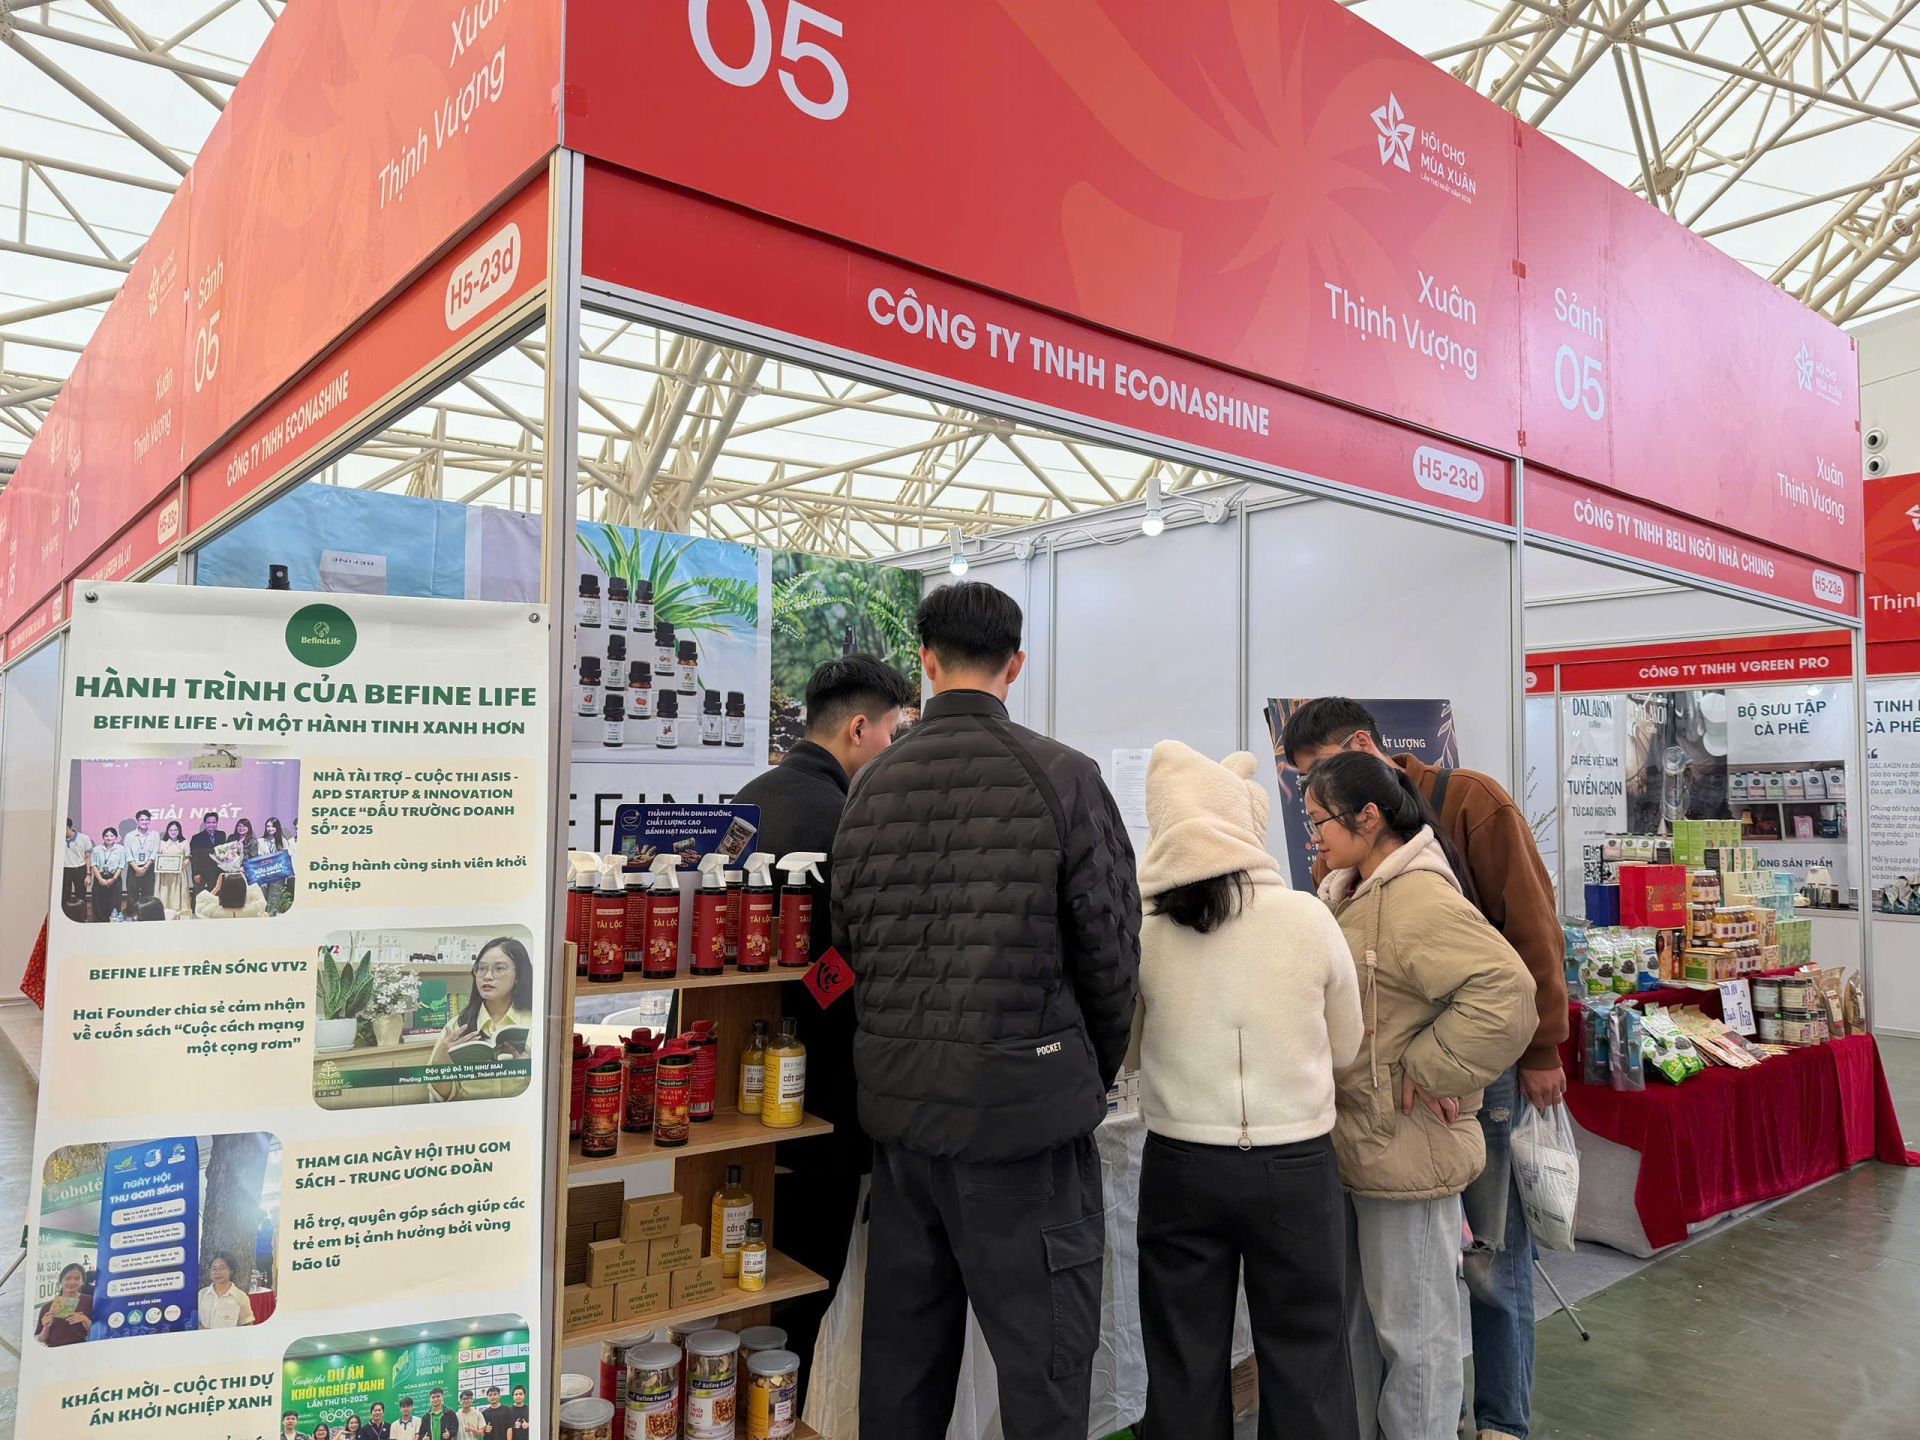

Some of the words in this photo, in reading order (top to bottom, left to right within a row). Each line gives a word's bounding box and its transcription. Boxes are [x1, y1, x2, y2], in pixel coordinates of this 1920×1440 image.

[688, 0, 849, 120] 05
[377, 136, 429, 210] Thịnh
[433, 44, 506, 133] Vượng
[1421, 129, 1440, 153] HỘI
[1442, 143, 1465, 168] CHỢ
[1421, 152, 1445, 179] MÙA
[1447, 167, 1476, 195] XUÂN
[197, 255, 224, 310] Sảnh
[451, 236, 514, 316] H5-23d
[1417, 270, 1476, 325] Xuân
[1554, 287, 1604, 342] Sảnh
[1324, 281, 1396, 342] Thịnh
[1402, 312, 1478, 381] Vượng
[194, 311, 221, 393] 05
[867, 287, 976, 350] CÔNG
[986, 324, 1019, 363] TY
[1030, 337, 1105, 389] TNHH
[1115, 364, 1269, 436] ECONASHINE
[1555, 344, 1605, 421] 05
[226, 454, 250, 488] CÔNG
[250, 444, 261, 470] TY
[261, 421, 284, 461] TNHH
[285, 369, 350, 445] ECONASHINE
[1419, 454, 1479, 492] H5-23d
[1816, 456, 1844, 489] Xuân
[1777, 471, 1808, 507] Thịnh
[1809, 487, 1845, 525] Vượng
[1573, 498, 1613, 531] CÔNG
[1617, 512, 1630, 536] TY
[1633, 519, 1663, 547] TNHH
[1666, 528, 1687, 554] BELI
[1689, 534, 1716, 563] NGÔI
[1718, 541, 1740, 569] NHÀ
[1741, 552, 1775, 580] CHUNG
[1814, 575, 1842, 599] H5-23e
[301, 636, 341, 646] BefineLife
[1639, 665, 1679, 679] CÔNG
[1682, 665, 1699, 677] TY
[1701, 662, 1737, 675] TNHH
[1740, 658, 1795, 672] VGREEN
[1799, 656, 1829, 669] PRO
[75, 666, 176, 699] HÀNH
[185, 670, 286, 702] TRÌNH
[293, 673, 357, 704] CỦA
[365, 684, 472, 706] BEFINE
[479, 687, 536, 707] LIFE
[1737, 704, 1757, 720] BỘ
[1761, 703, 1791, 716] SƯU
[1797, 699, 1826, 717] TẬP
[1874, 700, 1913, 713] TINH
[93, 715, 170, 730] BEFINE
[174, 716, 217, 730] LIFE
[232, 711, 253, 731] VÌ
[258, 713, 303, 737] MỘT
[308, 713, 366, 733] HÀNH
[371, 720, 419, 734] TINH
[423, 721, 478, 735] XANH
[482, 721, 525, 735] HƠN
[1754, 722, 1774, 736] CÀ
[1778, 719, 1810, 735] PHÊ
[1867, 718, 1885, 734] CÀ
[1382, 734, 1392, 747] ẤT
[1394, 738, 1426, 751] LƯỢNG
[313, 768, 346, 782] NHÀ
[348, 768, 371, 782] TÀI
[374, 770, 403, 785] TRỢ
[414, 769, 453, 785] CUỘC
[456, 772, 478, 782] THI
[481, 772, 511, 782] ASIS
[1567, 774, 1597, 795] TUYỂN
[1600, 780, 1622, 799] CHỌN
[312, 789, 342, 799] APD
[345, 789, 410, 800] STARTUP
[412, 790, 421, 799] &
[423, 788, 513, 799] INNOVATION
[311, 806, 357, 817] SPACE
[359, 800, 398, 817] “ĐẤU
[401, 802, 461, 817] TRƯỜNG
[463, 805, 515, 817] DOANH
[648, 808, 670, 816] THÀNH
[671, 808, 690, 816] PHẦN
[310, 818, 339, 835] SỐ”
[341, 825, 373, 835] 2025
[646, 818, 663, 826] CHẤT
[665, 828, 679, 836] HẠT
[1782, 857, 1802, 868] SẢN
[1805, 855, 1833, 868] PHẨM
[596, 921, 608, 929] TÀI
[609, 919, 623, 930] LỘC
[653, 918, 664, 926] TÀI
[750, 914, 760, 923] TÀI
[1036, 1042, 1061, 1056] POCKET
[296, 1155, 340, 1169] THAM
[343, 1153, 369, 1165] GIA
[372, 1145, 412, 1163] NGÀY
[415, 1142, 443, 1162] HỘI
[445, 1144, 476, 1157] THU
[478, 1140, 511, 1153] GOM
[123, 1174, 151, 1190] NGÀY
[153, 1172, 171, 1184] HỘI
[295, 1172, 336, 1190] SÁCH
[349, 1169, 401, 1185] TRUNG
[403, 1164, 448, 1180] ƯƠNG
[450, 1158, 493, 1176] ĐOÀN
[109, 1195, 129, 1205] THU
[131, 1190, 155, 1201] GOM
[157, 1182, 184, 1196] SÁCH
[61, 1387, 123, 1409] KHÁCH
[127, 1380, 159, 1398] MỜI
[173, 1375, 217, 1396] CUỘC
[220, 1376, 246, 1389] THI
[250, 1372, 274, 1389] DỰ
[358, 1378, 385, 1392] XANH
[89, 1408, 114, 1426] ÁN
[118, 1401, 161, 1422] KHỞI
[165, 1396, 225, 1416] NGHIỆP
[228, 1395, 273, 1410] XANH
